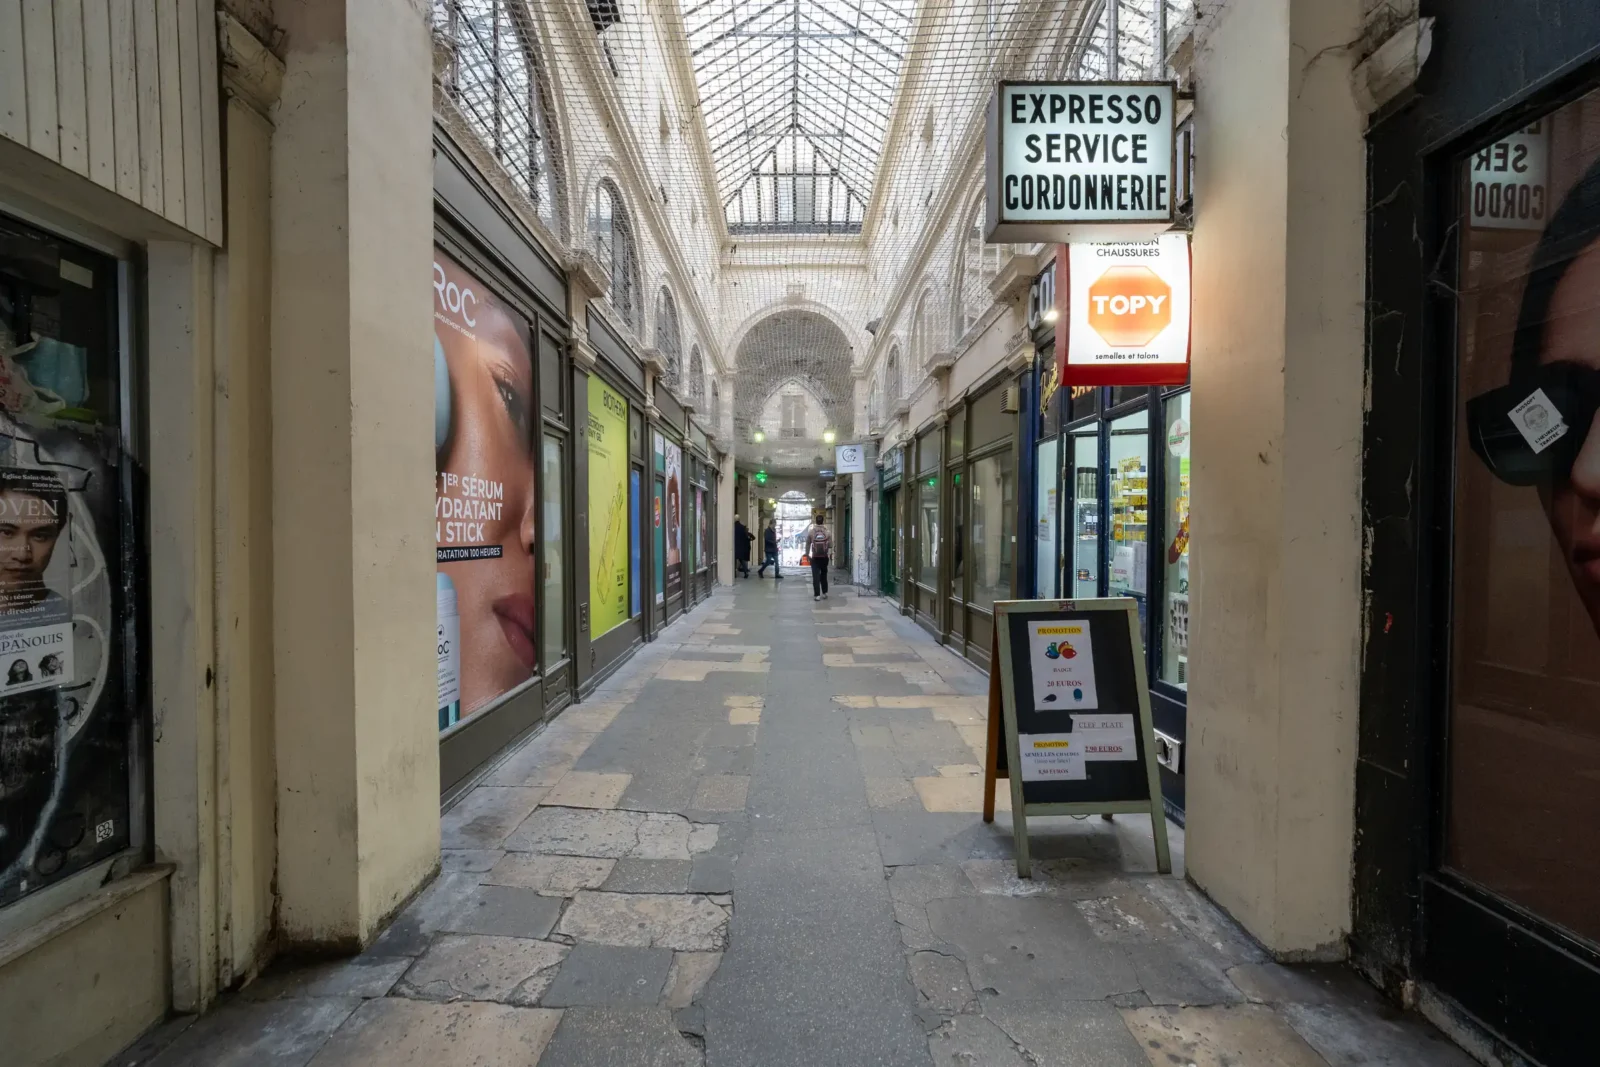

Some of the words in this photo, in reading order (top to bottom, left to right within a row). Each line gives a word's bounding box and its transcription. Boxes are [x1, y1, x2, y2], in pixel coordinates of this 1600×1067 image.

[1011, 94, 1161, 124] EXPRESSO
[1024, 133, 1148, 163] SERVICE
[1005, 174, 1167, 210] CORDONNERIE
[1096, 248, 1160, 257] CHAUSSURES
[1092, 295, 1167, 315] TOPY
[1095, 352, 1125, 360] semelles
[1128, 352, 1135, 360] et
[1137, 352, 1159, 360] talons
[461, 473, 503, 500] SÉRUM
[446, 522, 485, 543] STICK
[7, 606, 46, 615] direction
